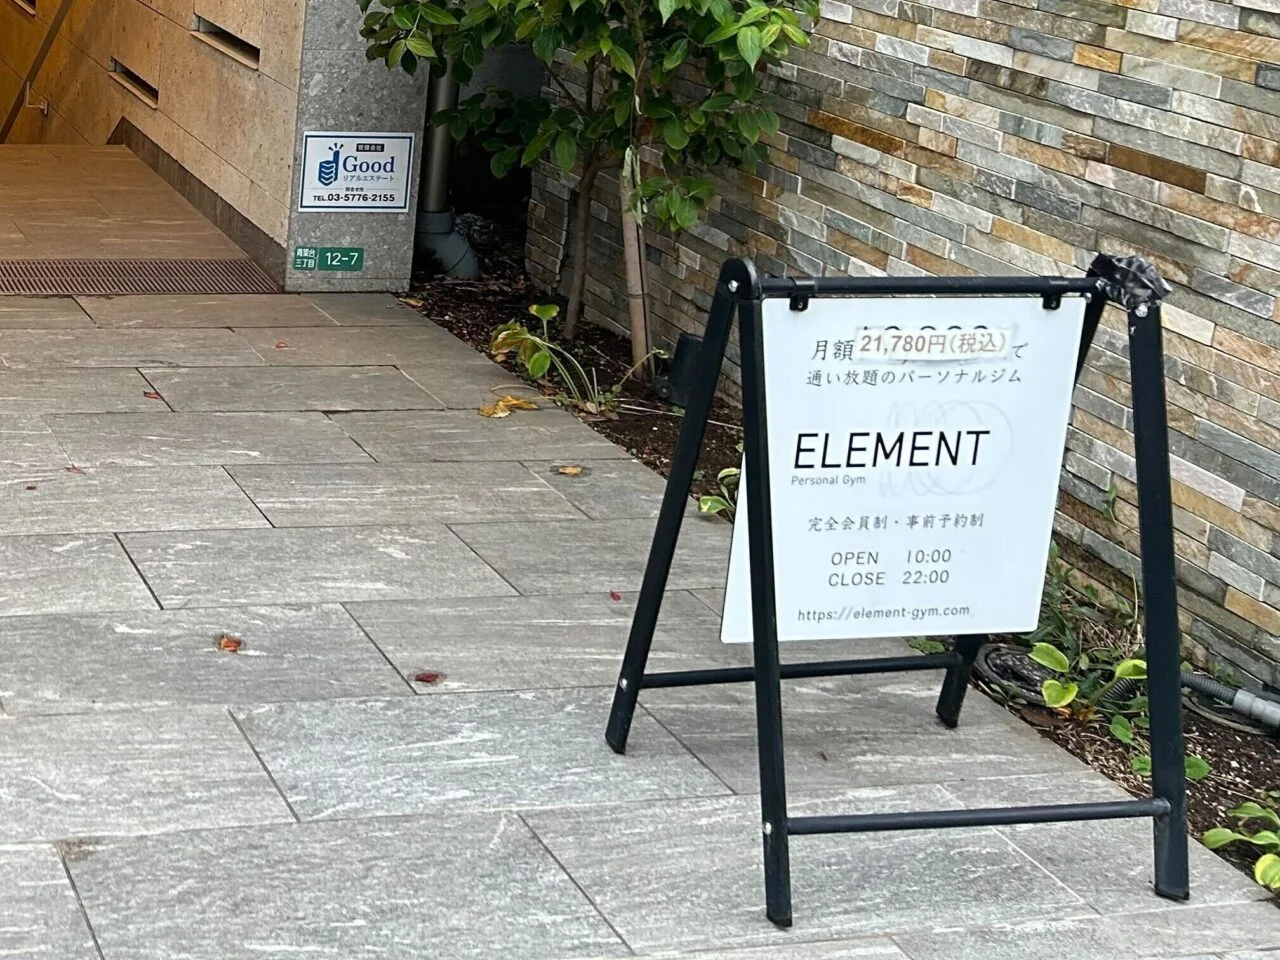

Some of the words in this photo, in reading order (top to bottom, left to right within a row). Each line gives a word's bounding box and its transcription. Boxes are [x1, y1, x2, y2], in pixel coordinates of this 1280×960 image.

[342, 155, 395, 173] Good
[325, 252, 359, 266] 12-7
[806, 369, 1022, 387] 通い放題のパーソナルジム
[793, 430, 990, 469] ELEMENT
[791, 474, 839, 486] Personal
[842, 473, 866, 486] Gym
[808, 513, 984, 532] 完全会員制・事前予約制
[831, 551, 879, 566] OPEN
[907, 549, 952, 563] 10:00
[828, 572, 885, 587] CLOSE
[902, 570, 950, 584] 22:00
[798, 605, 970, 623] https://element-gym.com
